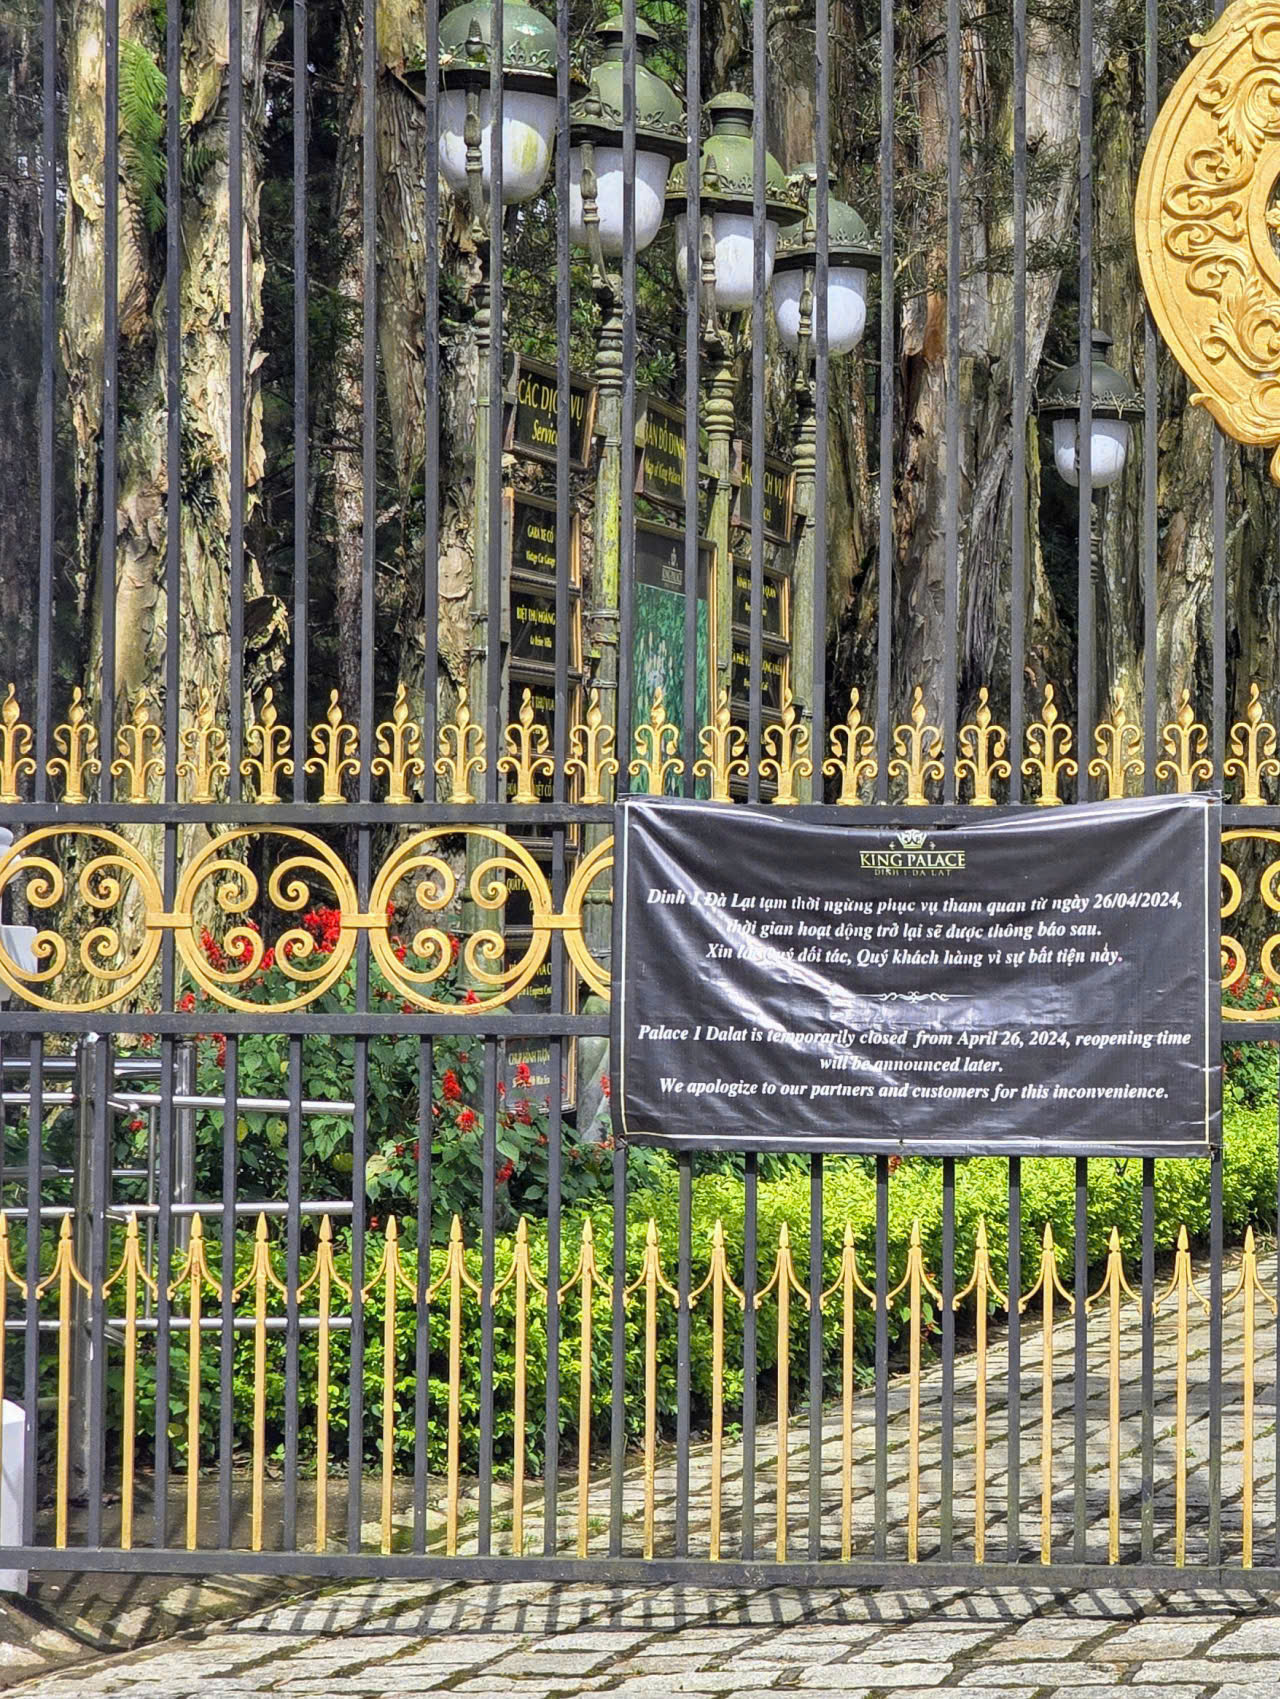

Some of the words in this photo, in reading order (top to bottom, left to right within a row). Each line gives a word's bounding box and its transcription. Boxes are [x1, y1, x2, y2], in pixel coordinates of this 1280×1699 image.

[518, 373, 539, 408] CÁC
[570, 394, 584, 427] VỤ
[860, 853, 902, 867] KING
[907, 853, 966, 867] PALACE
[646, 888, 686, 905] Dinh
[703, 891, 727, 908] Đà
[731, 892, 756, 911] Lạt
[759, 895, 787, 912] tạm
[791, 895, 821, 911] thời
[824, 897, 873, 915] ngừng
[876, 897, 916, 915] phục
[921, 900, 938, 916] vụ
[942, 898, 982, 913] tham
[986, 901, 1026, 917] quan
[1031, 896, 1048, 912] từ
[1052, 895, 1089, 914] ngày
[1093, 891, 1183, 910] 26/04/2024,
[760, 920, 794, 939] gian
[798, 921, 832, 940] hoạt
[876, 922, 900, 938] trở
[903, 923, 922, 941] lại
[926, 924, 943, 939] sẽ
[988, 923, 1033, 941] thông
[1037, 921, 1066, 937] báo
[1070, 923, 1102, 937] sau.
[705, 943, 733, 959] Xin
[825, 948, 852, 966] tác,
[857, 948, 889, 968] Quý
[892, 948, 939, 965] khách
[943, 949, 982, 968] hàng
[988, 950, 1001, 965] vì
[1005, 952, 1024, 968] sự
[1028, 945, 1053, 964] bất
[1056, 948, 1085, 967] tiện
[638, 1024, 688, 1041] Palace
[705, 1025, 748, 1041] Dalat
[751, 1027, 763, 1042] is
[767, 1028, 855, 1046] temporarily
[859, 1030, 907, 1045] closed
[912, 1029, 953, 1048] from
[957, 1030, 997, 1049] April
[1000, 1030, 1024, 1048] 26,
[1028, 1031, 1071, 1049] 2024,
[1075, 1030, 1153, 1048] reopening
[1157, 1030, 1191, 1045] time
[820, 1055, 849, 1070] will
[852, 1056, 871, 1071] be
[873, 1056, 960, 1073] announced
[963, 1056, 1003, 1073] later.
[660, 1077, 684, 1093] We
[687, 1078, 758, 1098] apologize
[761, 1079, 776, 1095] to
[780, 1083, 808, 1096] our
[810, 1081, 874, 1099] partners
[878, 1082, 909, 1098] and
[912, 1084, 990, 1099] customers
[991, 1083, 1017, 1102] for
[1021, 1083, 1049, 1099] this
[1053, 1083, 1169, 1099] inconvenience.
